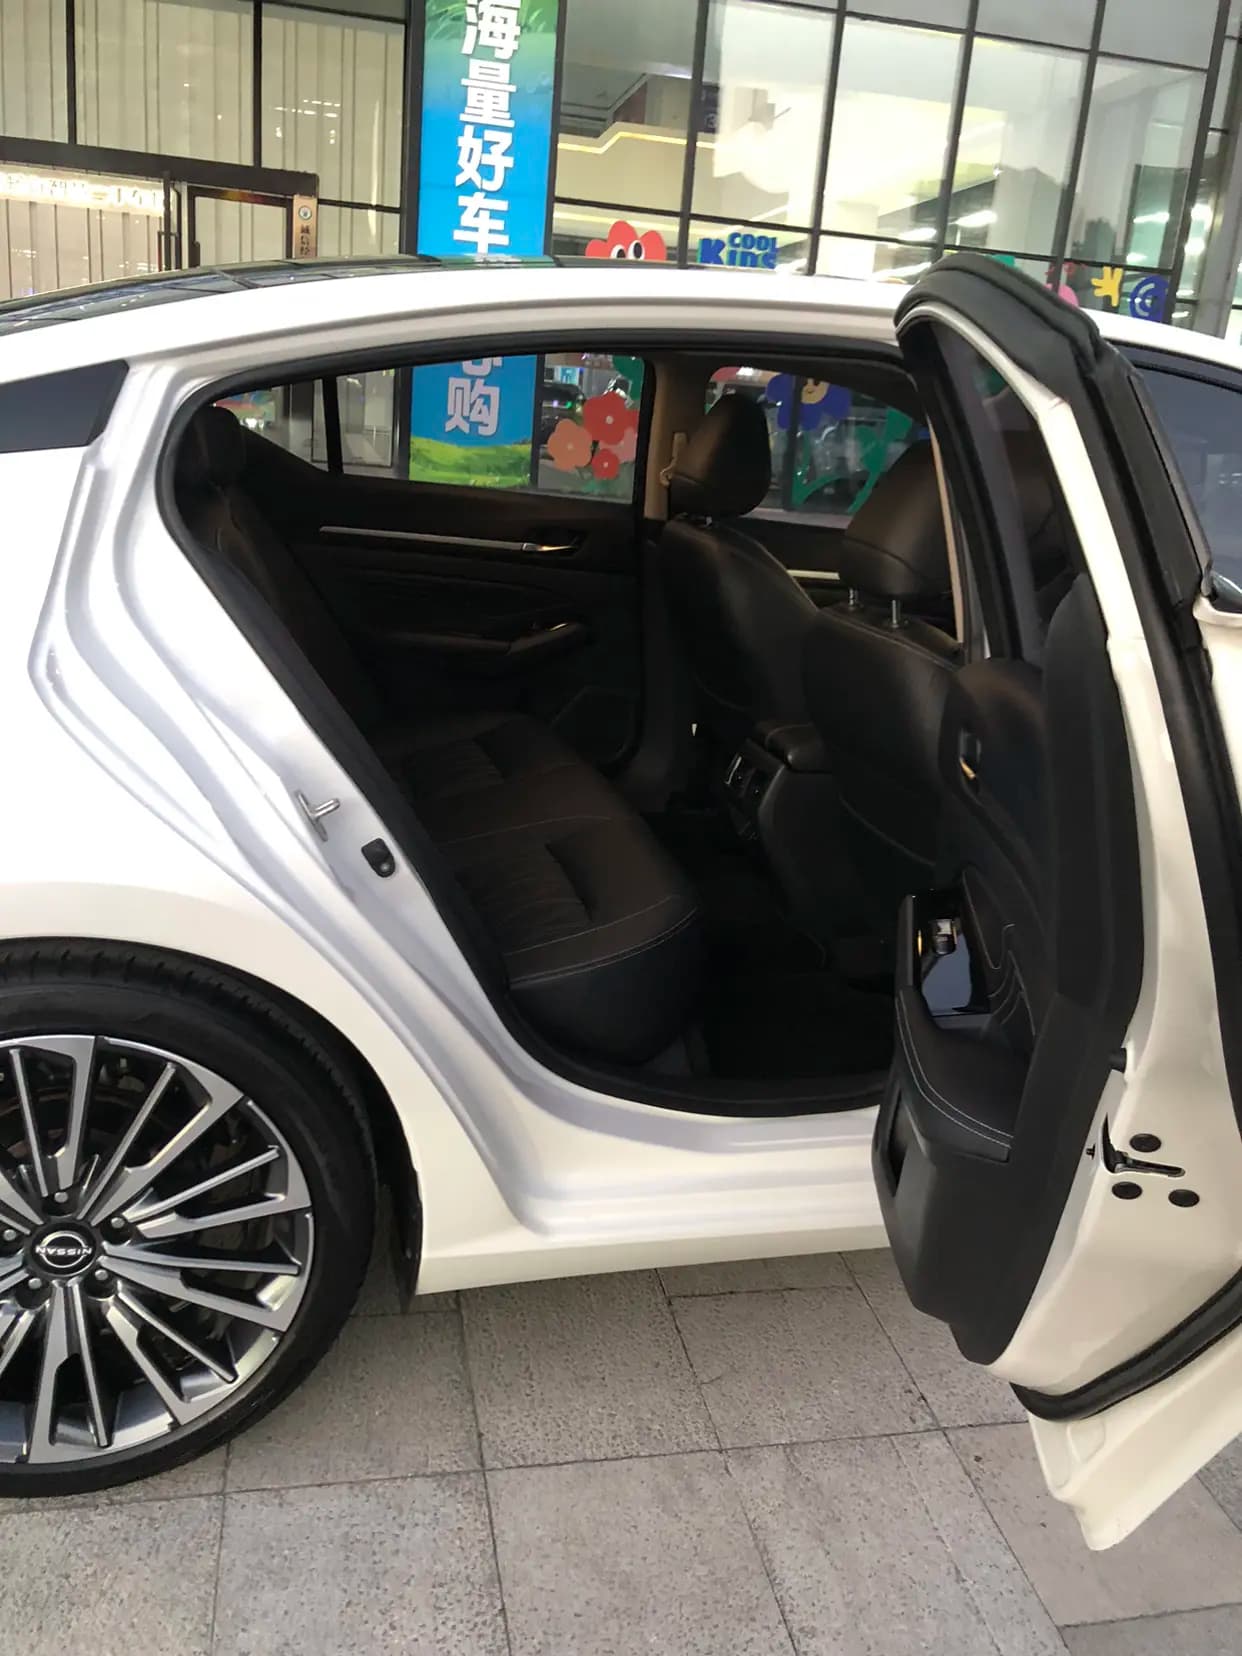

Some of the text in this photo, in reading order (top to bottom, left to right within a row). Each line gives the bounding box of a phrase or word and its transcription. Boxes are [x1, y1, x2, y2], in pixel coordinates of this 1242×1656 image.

[453, 0, 521, 254] 海量好车
[727, 232, 778, 252] COOL
[35, 1245, 92, 1257] NISSAN
